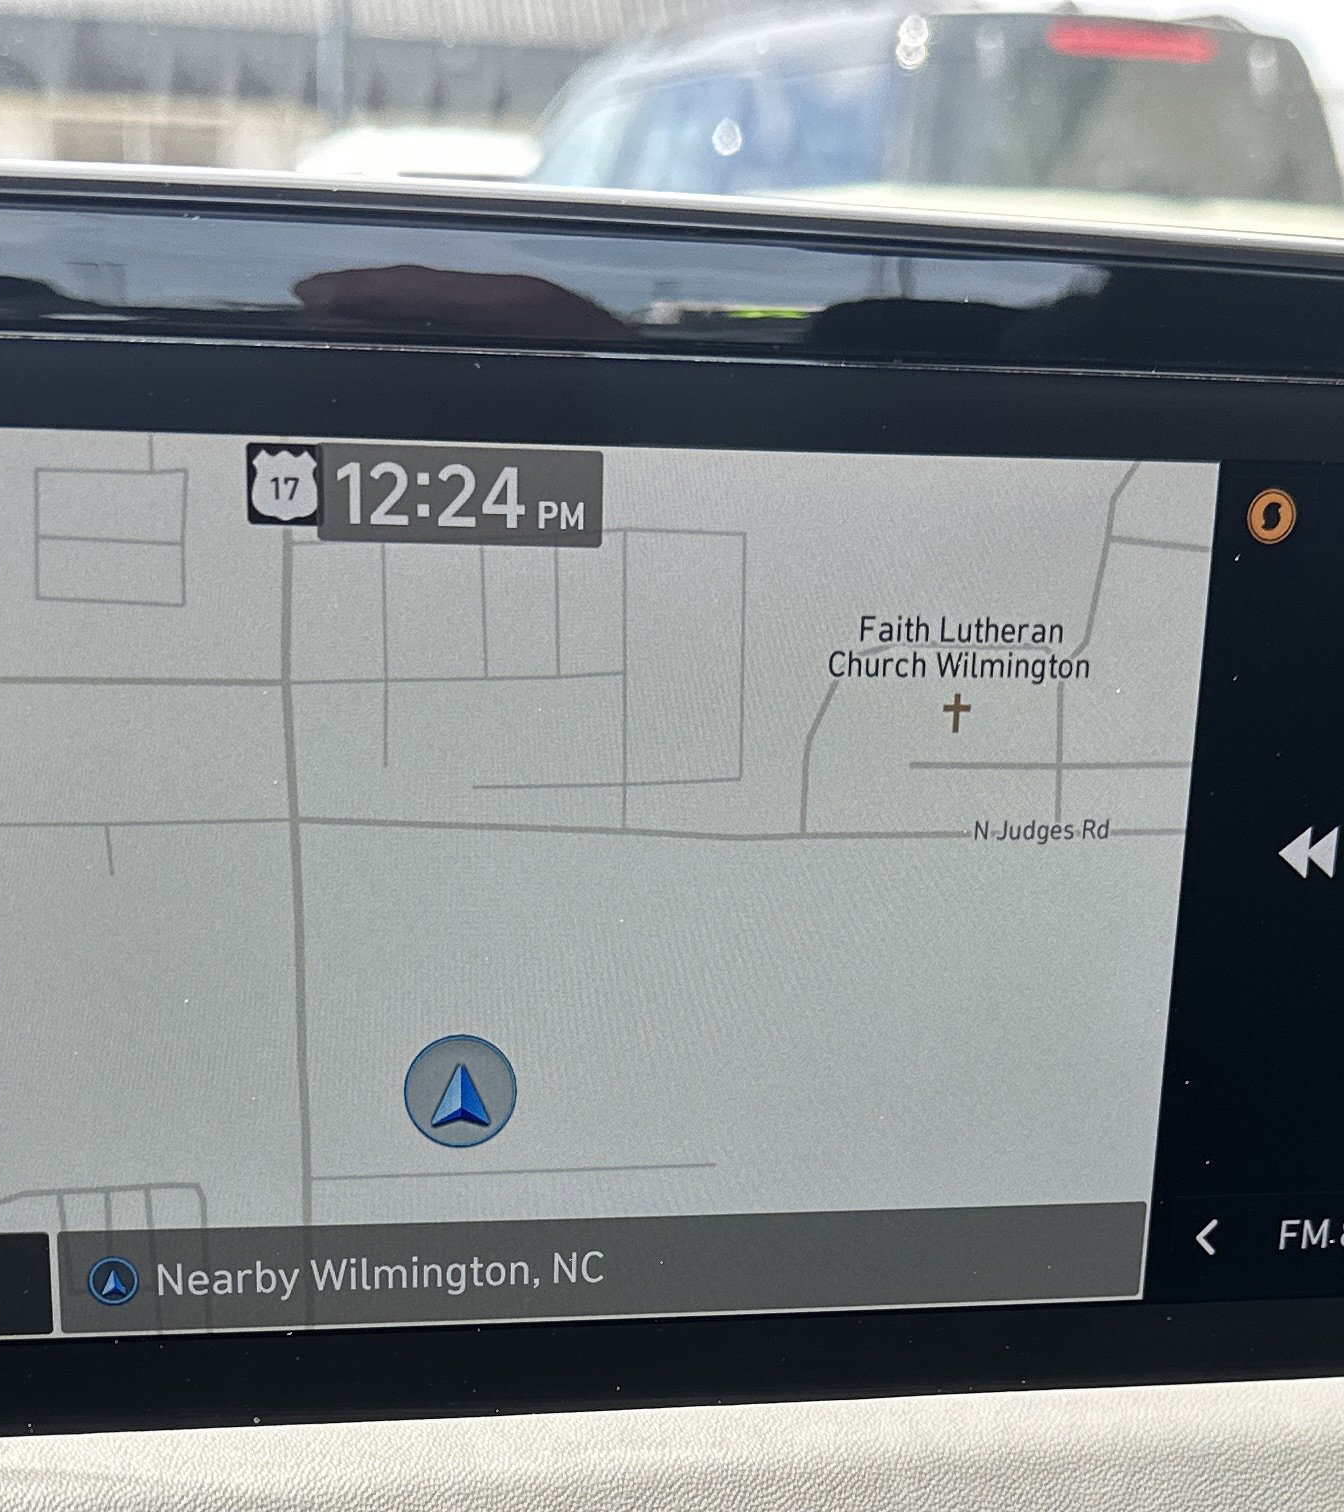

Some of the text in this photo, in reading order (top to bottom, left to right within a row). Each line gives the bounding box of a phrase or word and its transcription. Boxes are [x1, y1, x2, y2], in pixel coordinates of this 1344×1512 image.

[271, 477, 299, 500] 17
[337, 462, 584, 530] 12:24 PM
[860, 616, 1063, 643] Faith Lutheran
[829, 651, 1089, 684] Church Wilmington
[974, 818, 1110, 845] N Judges Rd
[1279, 1219, 1328, 1249] FM
[158, 1251, 603, 1300] Nearby Wilmington, NC
